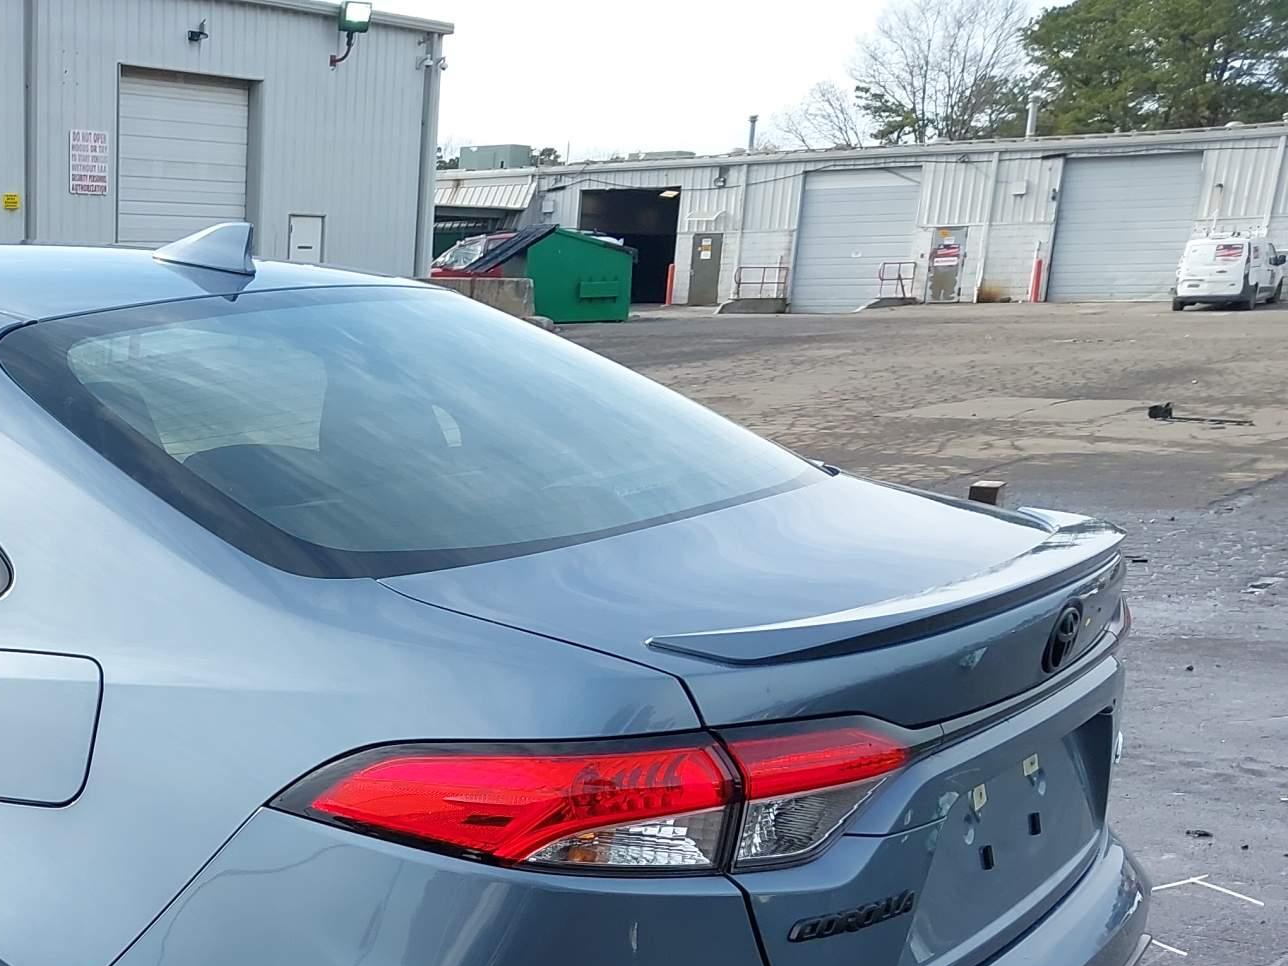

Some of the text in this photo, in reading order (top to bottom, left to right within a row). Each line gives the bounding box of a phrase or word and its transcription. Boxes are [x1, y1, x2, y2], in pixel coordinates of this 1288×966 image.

[73, 131, 106, 144] DO NOT OPEN
[91, 145, 97, 153] OR
[787, 889, 916, 942] COROLLA
